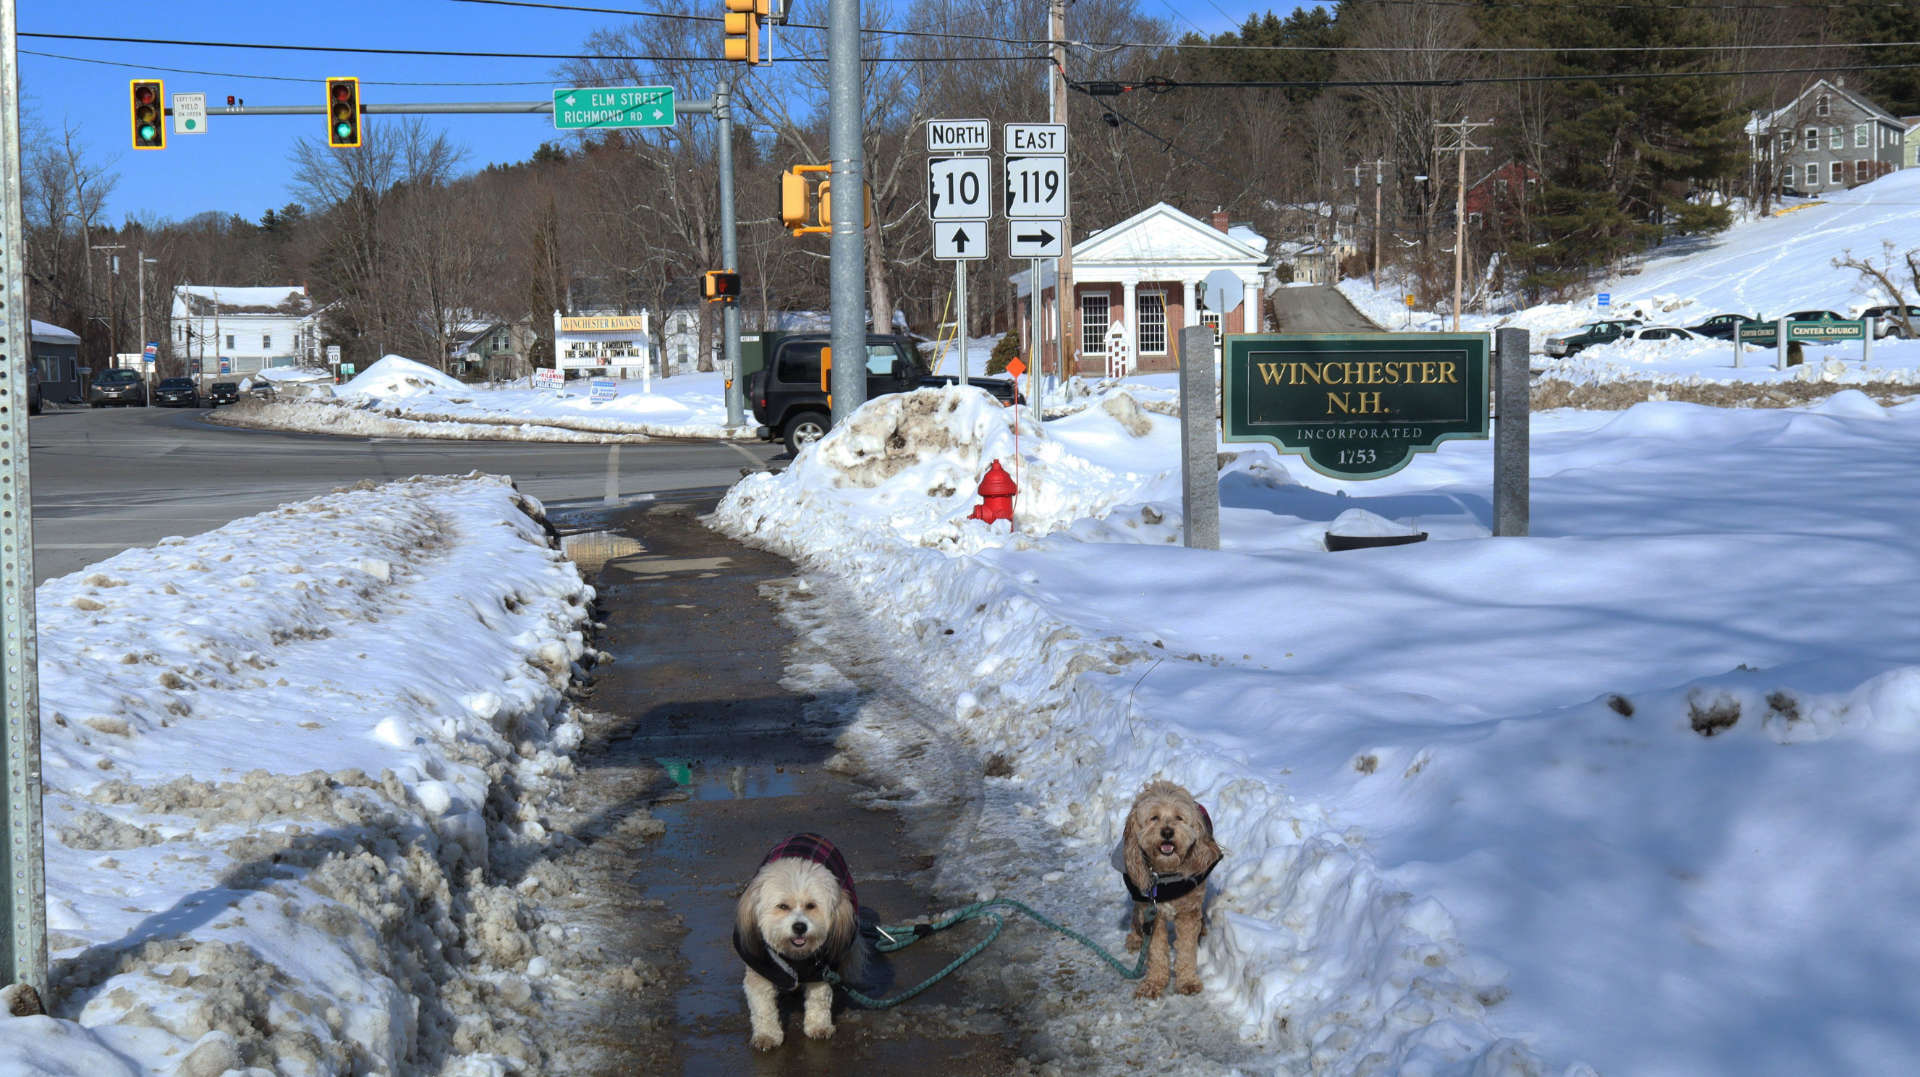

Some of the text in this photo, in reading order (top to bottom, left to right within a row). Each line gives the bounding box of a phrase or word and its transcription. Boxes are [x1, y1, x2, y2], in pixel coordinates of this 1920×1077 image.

[591, 92, 664, 107] ELM STREET
[564, 110, 643, 123] RICHMOND RD
[932, 125, 985, 145] NORTH
[1014, 129, 1056, 149] EAST
[945, 171, 980, 205] 10
[1020, 170, 1059, 204] 119
[562, 317, 641, 330] WINCHESTER KIWANIS
[1793, 326, 1859, 335] CENTER CHURCH
[564, 348, 640, 358] THIS SUNDAY AT TOWN HALL
[571, 341, 633, 350] MEET THE CANDIDATES
[1257, 362, 1458, 385] WINCHESTER
[1325, 391, 1391, 415] N.H.
[1297, 427, 1423, 440] INCORPORATED
[1337, 449, 1377, 465] 1753
